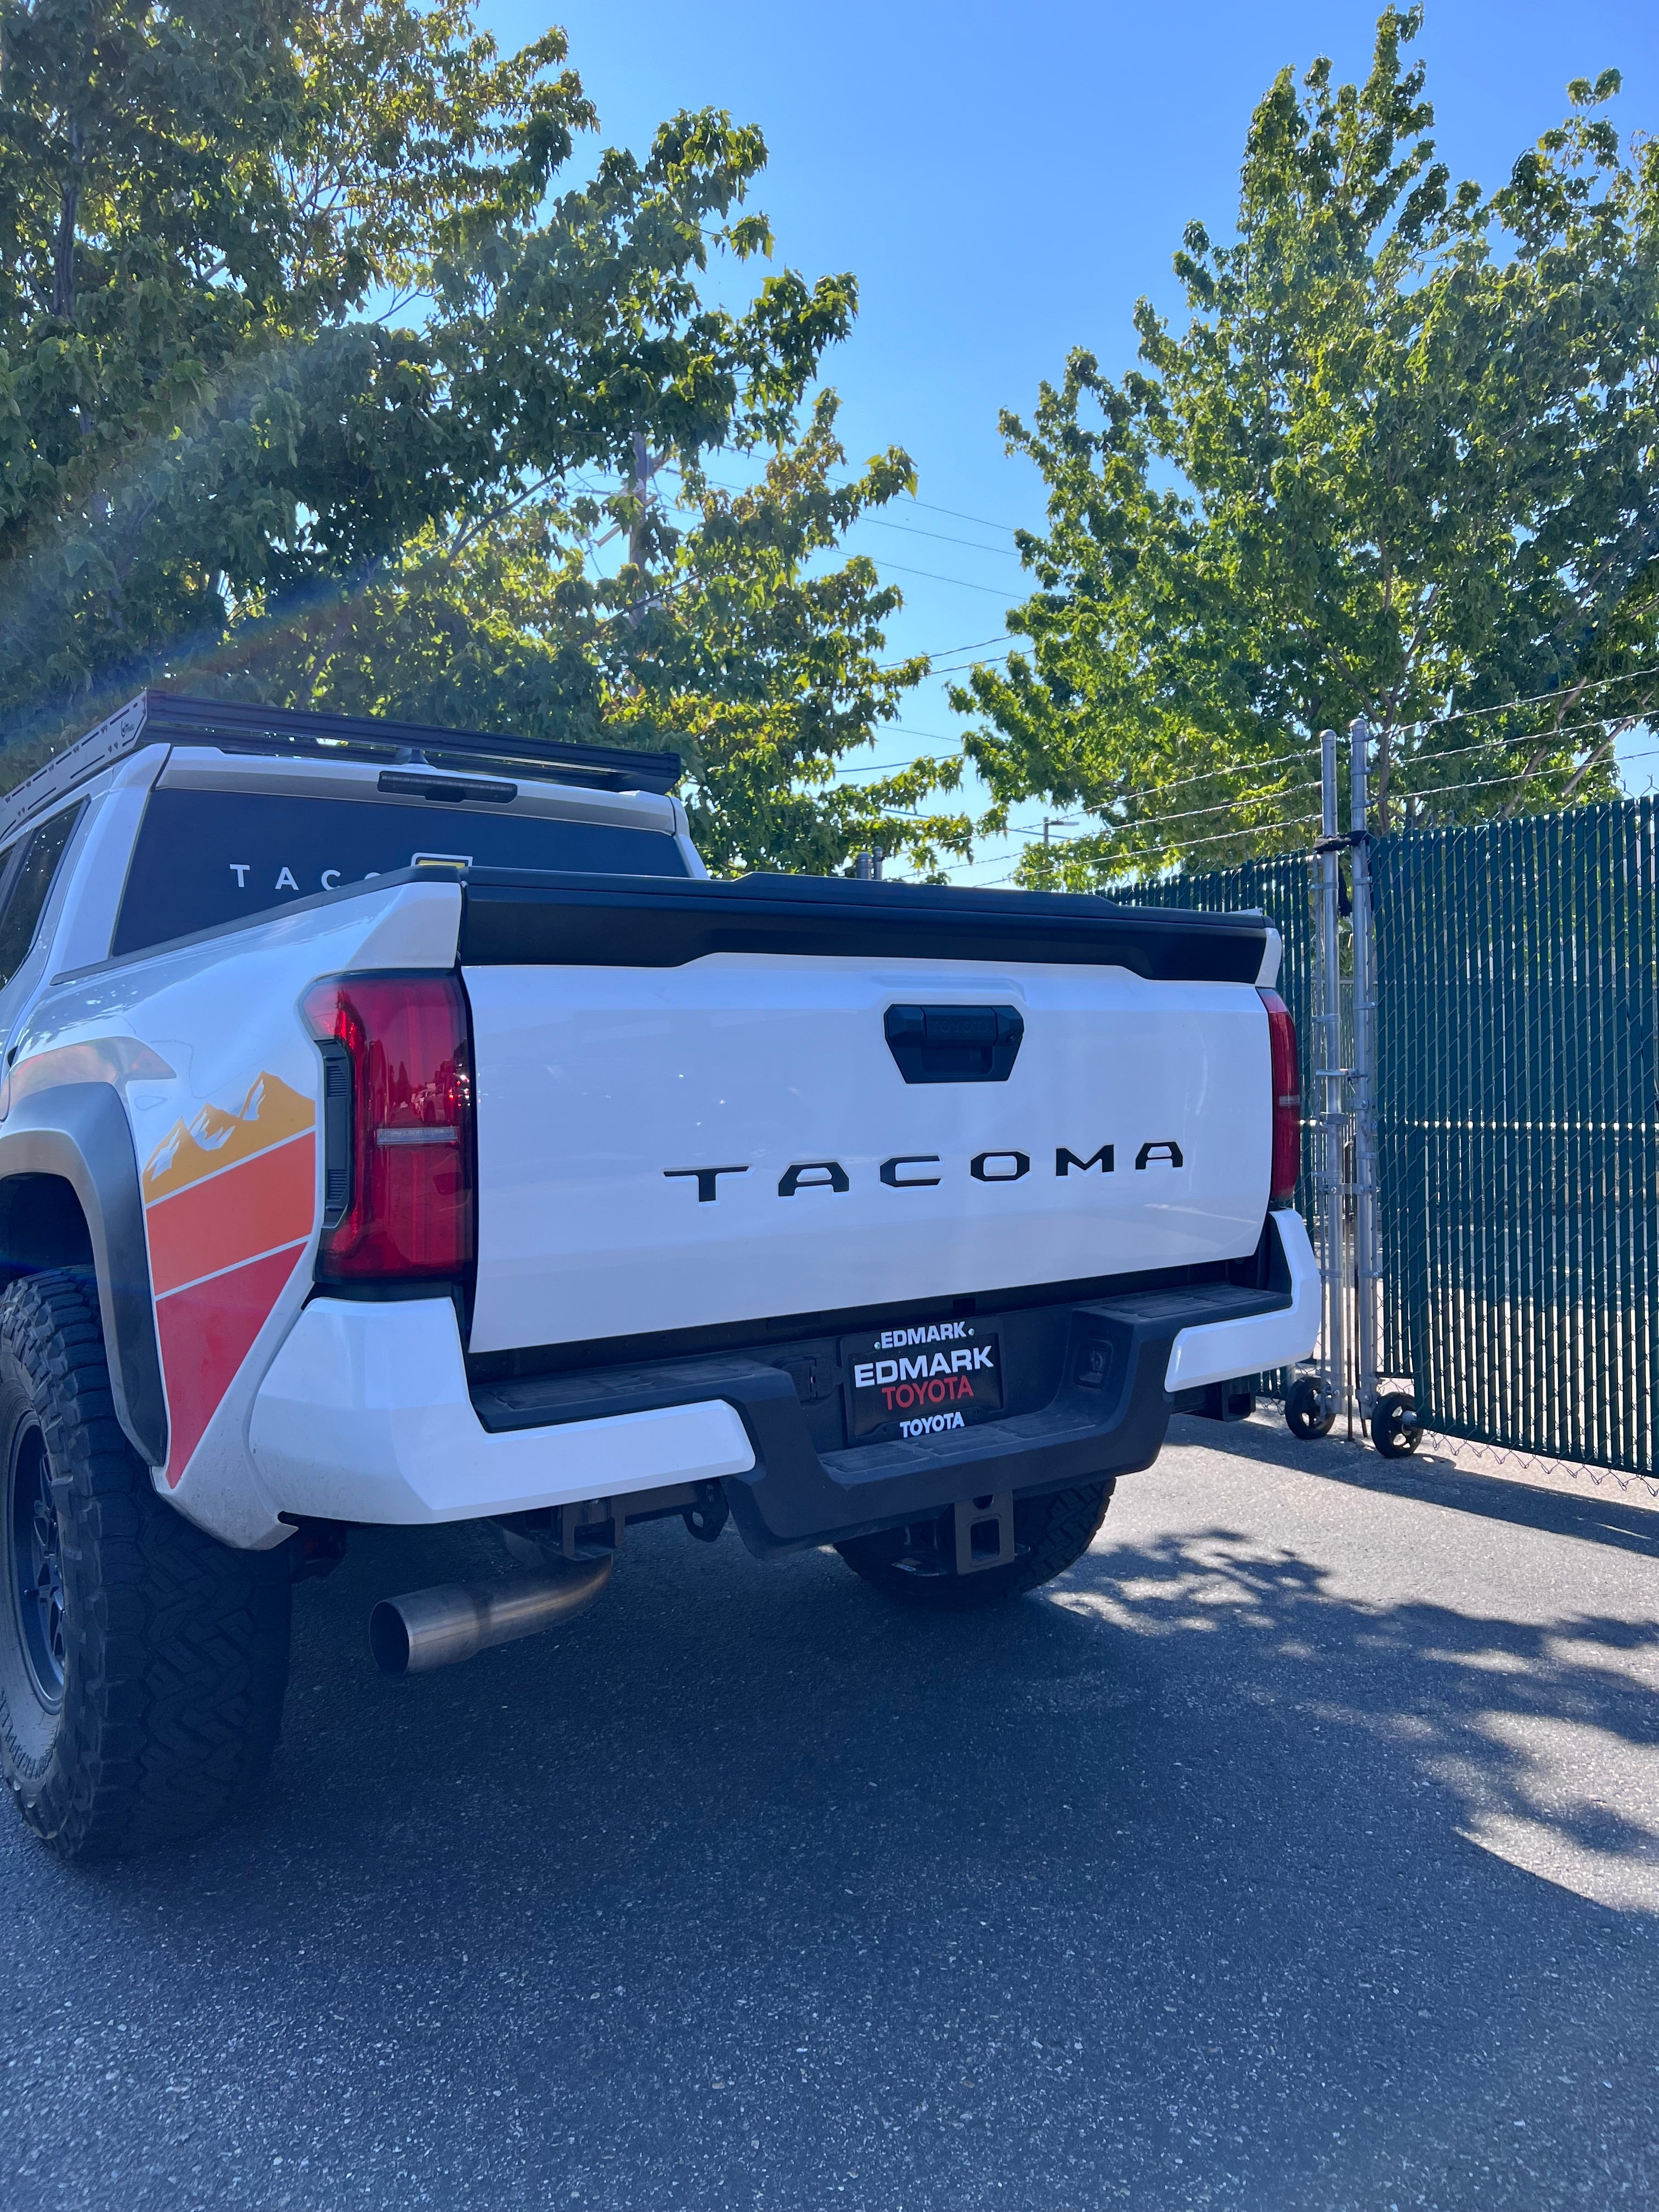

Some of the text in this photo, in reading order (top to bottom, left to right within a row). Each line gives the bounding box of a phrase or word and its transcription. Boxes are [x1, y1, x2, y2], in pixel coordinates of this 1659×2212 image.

[229, 864, 382, 890] TAC
[929, 1018, 993, 1032] TOYOTA
[663, 1142, 1183, 1202] TACOMA
[881, 1321, 967, 1349] EDMARK
[854, 1346, 994, 1388] EDMARK
[882, 1375, 974, 1410] TOYOTA
[900, 1411, 965, 1438] TOYOTA
